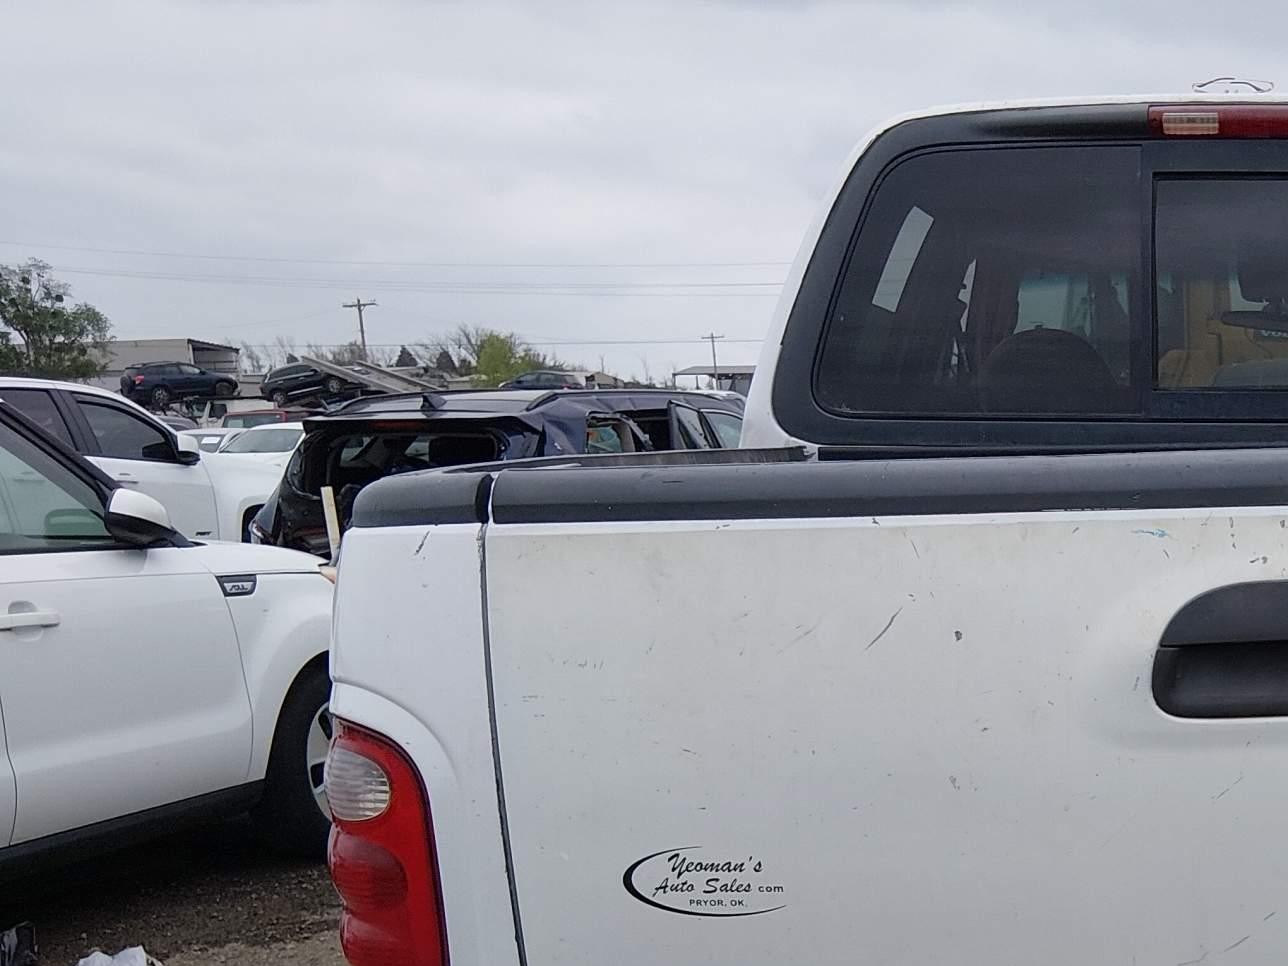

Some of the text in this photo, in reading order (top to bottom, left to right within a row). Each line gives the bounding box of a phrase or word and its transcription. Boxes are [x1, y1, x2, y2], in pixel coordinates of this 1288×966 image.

[667, 853, 763, 879] Yeoman's
[652, 877, 696, 897] Auto
[702, 877, 752, 894] Sales
